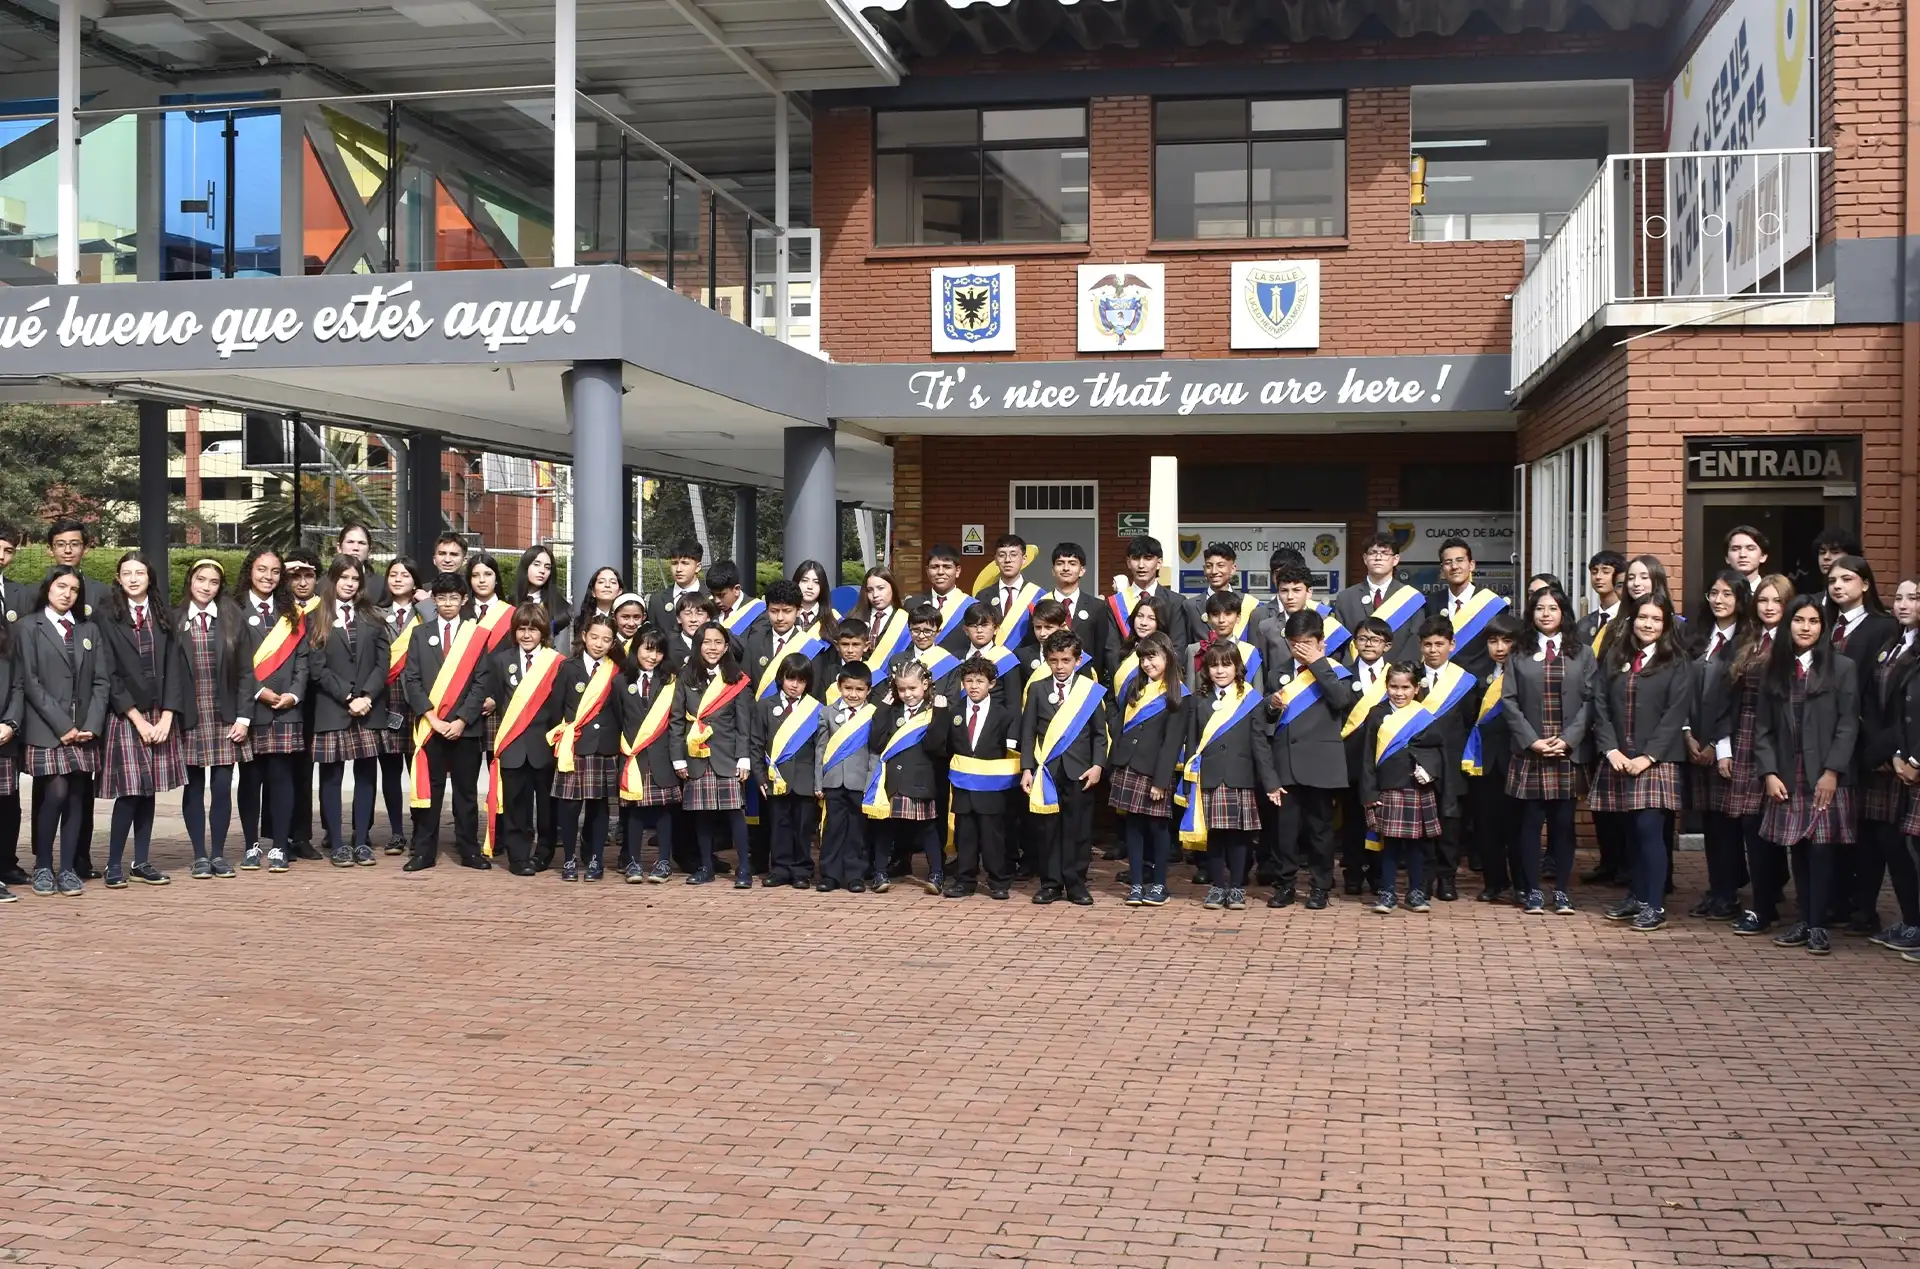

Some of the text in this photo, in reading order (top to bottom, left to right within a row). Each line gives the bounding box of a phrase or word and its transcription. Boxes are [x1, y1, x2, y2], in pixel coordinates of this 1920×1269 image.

[1675, 18, 1750, 220] LIVE JESUS
[1712, 62, 1767, 213] HEARTS
[1254, 271, 1299, 282] LA SALLE
[56, 295, 204, 347] bueno
[211, 307, 304, 358] que
[313, 280, 435, 341] estés
[443, 273, 591, 352] aquí!
[1248, 293, 1306, 334] LICEO HERMANO MIGUEL
[908, 366, 991, 410] It's
[1002, 379, 1080, 409] nice
[1082, 371, 1173, 408] that
[1177, 382, 1250, 416] you
[1260, 377, 1328, 405] are
[1699, 450, 1844, 477] ENTRADA
[1256, 541, 1269, 552] DE
[1272, 541, 1306, 552] HONOR
[1425, 528, 1470, 538] CUADRO
[1473, 528, 1487, 538] DE
